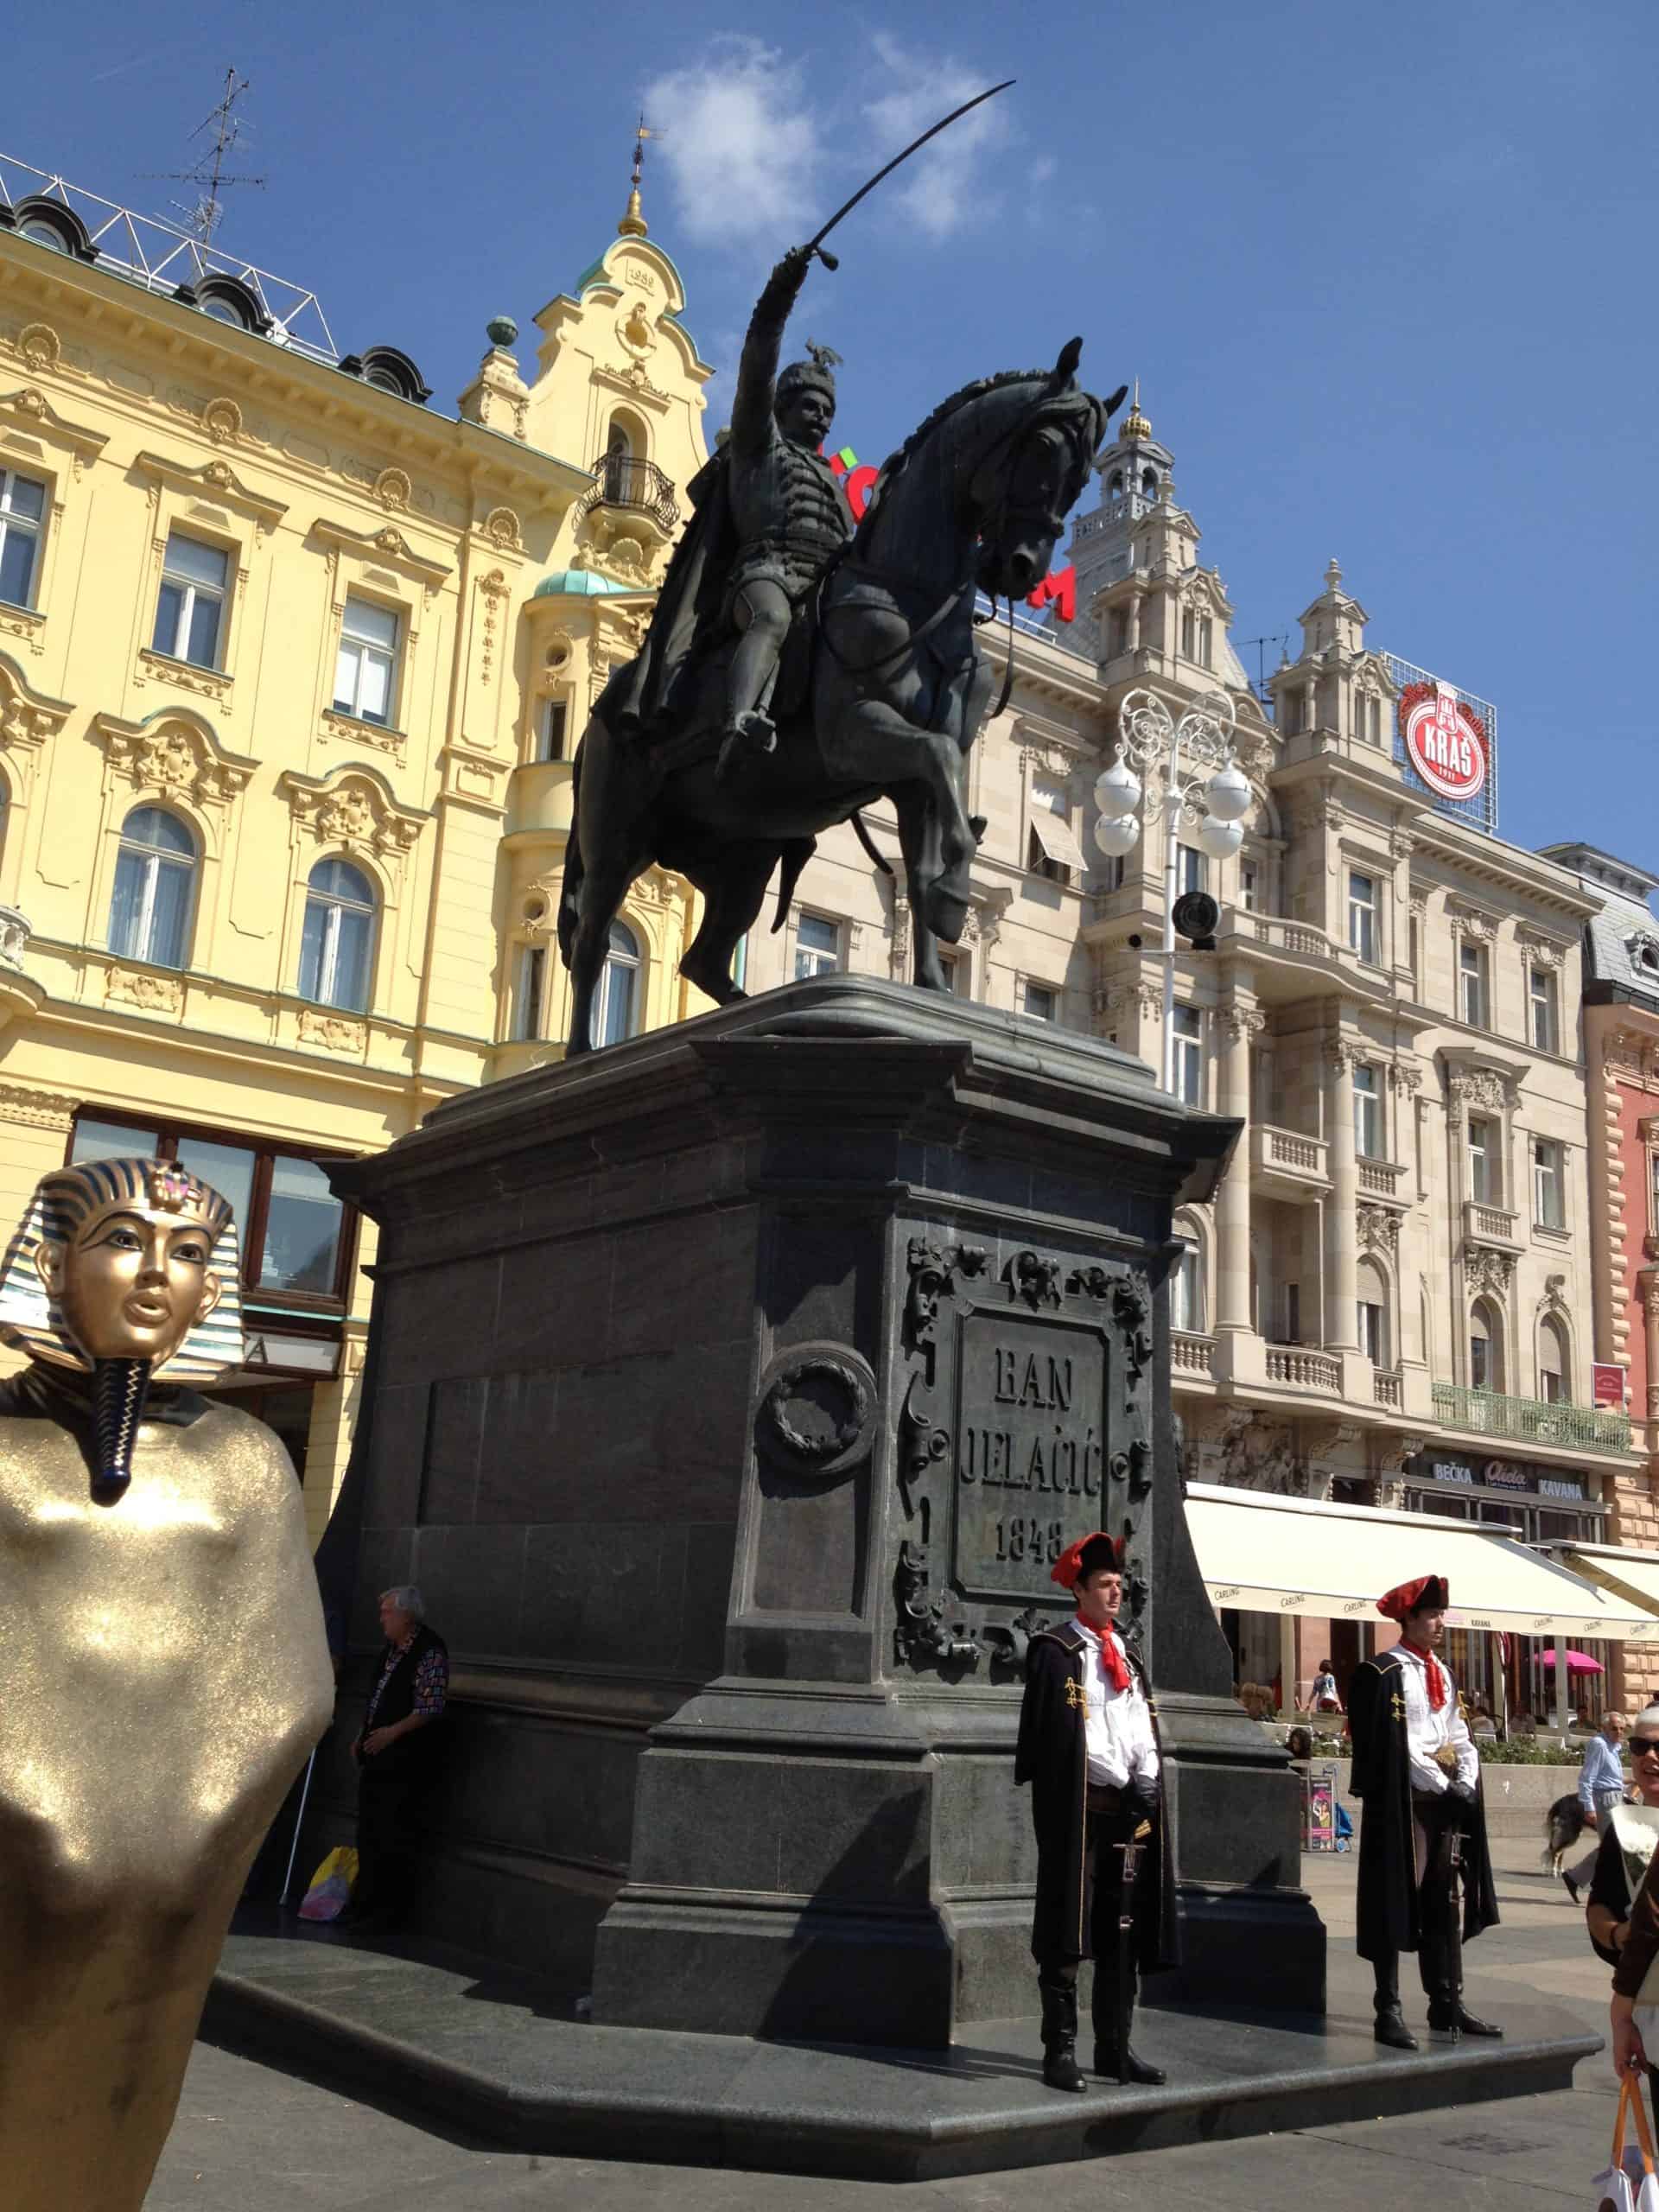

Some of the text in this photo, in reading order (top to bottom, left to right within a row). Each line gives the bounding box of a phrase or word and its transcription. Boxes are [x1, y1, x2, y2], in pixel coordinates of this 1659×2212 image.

[1424, 723, 1471, 777] KRAŠ
[1439, 766, 1456, 781] 1911
[995, 1348, 1071, 1411] BAN
[960, 1425, 1100, 1496] JELAČIĆ
[1433, 1461, 1472, 1484] BEČKA
[1539, 1478, 1582, 1500] KAVANA
[995, 1516, 1064, 1565] 1848
[1214, 1586, 1240, 1600] CARLING
[1281, 1594, 1306, 1608] CARLING
[1344, 1600, 1367, 1613] CARLING
